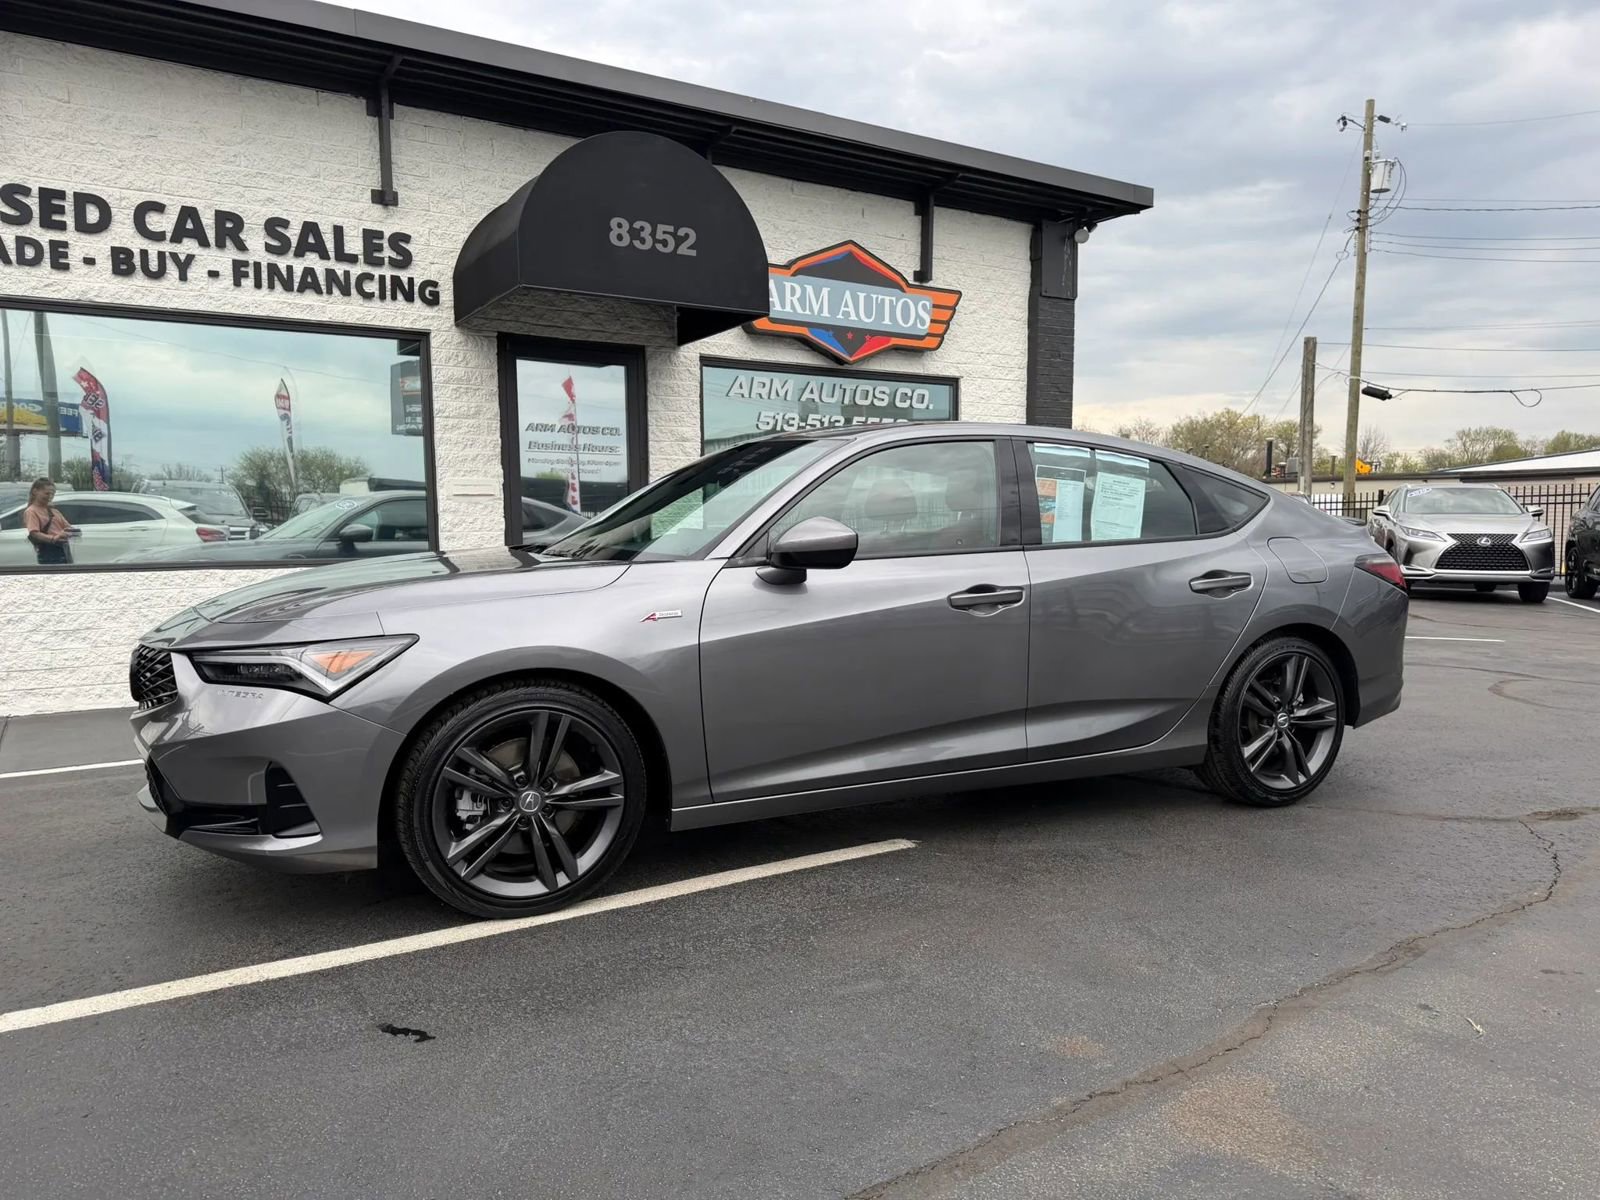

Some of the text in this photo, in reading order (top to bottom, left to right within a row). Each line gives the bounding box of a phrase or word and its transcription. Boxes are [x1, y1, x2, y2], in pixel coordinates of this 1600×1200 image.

[133, 200, 249, 251] CAR
[264, 216, 413, 269] SALES
[609, 216, 697, 257] 8352
[111, 246, 195, 281] BUY
[232, 259, 440, 305] FINANCING
[768, 278, 932, 329] ARM AUTOS
[726, 375, 934, 410] ARM AUTOS CO.
[526, 423, 556, 433] ARM
